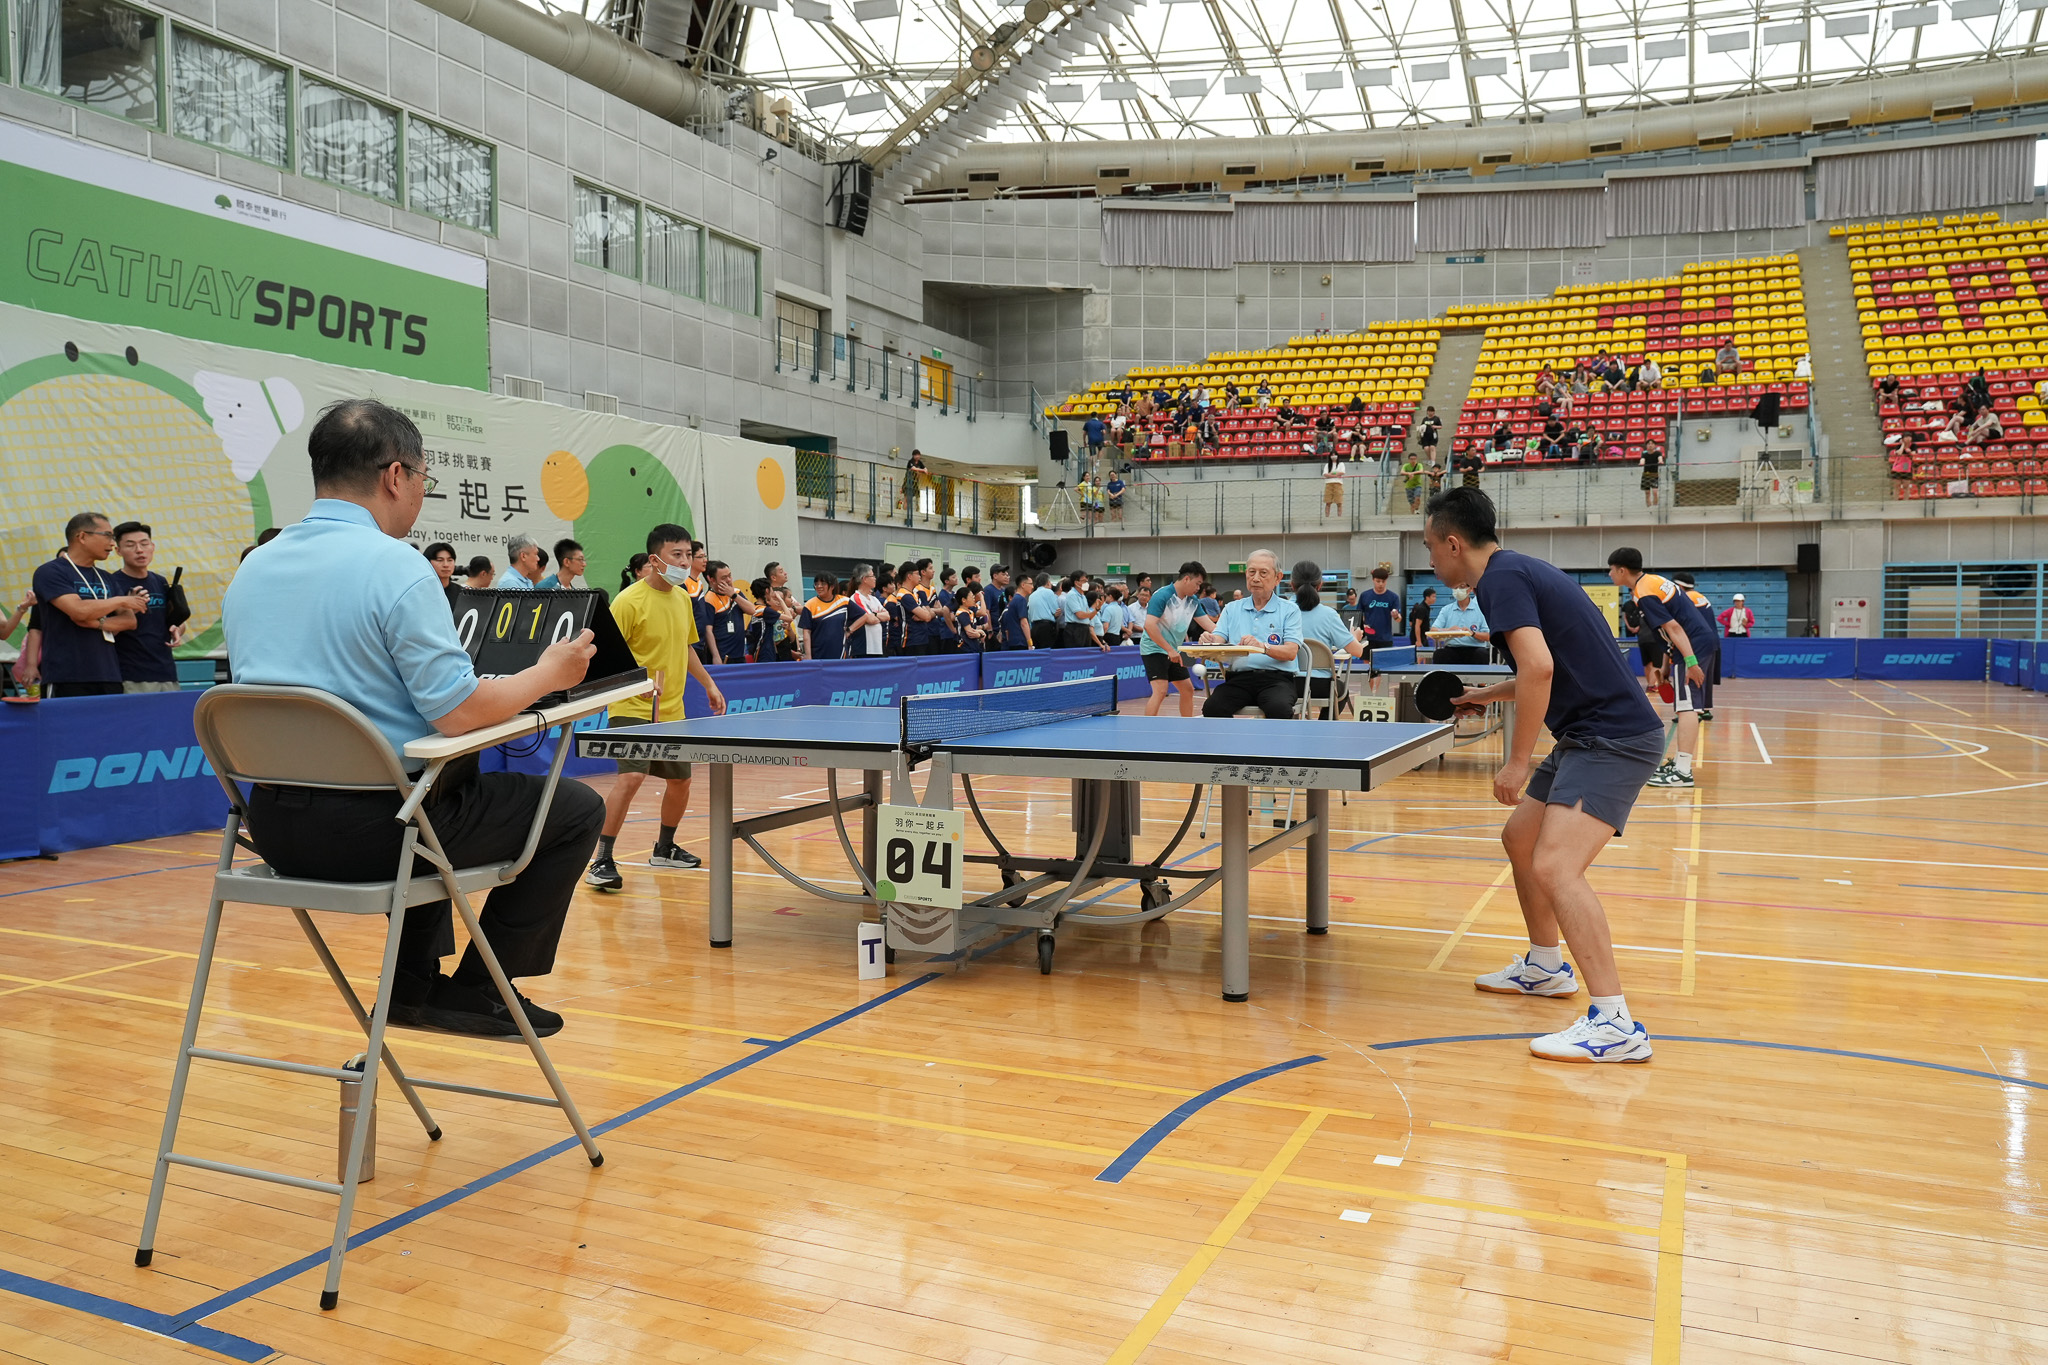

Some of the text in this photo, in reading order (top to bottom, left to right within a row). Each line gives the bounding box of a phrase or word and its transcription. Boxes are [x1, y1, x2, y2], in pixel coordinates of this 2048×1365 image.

[26, 228, 429, 356] CATHAYSPORTS
[387, 405, 436, 422] 世華銀行
[446, 414, 473, 425] BETTER
[447, 422, 483, 434] TOGETHER
[424, 478, 530, 523] 一起乒
[434, 529, 481, 544] together
[484, 535, 498, 544] we
[496, 602, 513, 639] 0
[529, 603, 543, 640] 1
[1759, 653, 1827, 665] DONIC
[1883, 653, 1955, 665] DONIC
[993, 666, 1042, 688] DONIC
[1116, 664, 1147, 680] DONIC
[726, 693, 795, 715] DONIC
[829, 687, 894, 707] DONIC
[689, 751, 730, 763] WORLD
[732, 753, 790, 766] CHAMPION
[792, 756, 808, 767] TC
[895, 817, 945, 831] 羽你一起乒
[886, 837, 952, 889] 04
[861, 937, 882, 965] T
